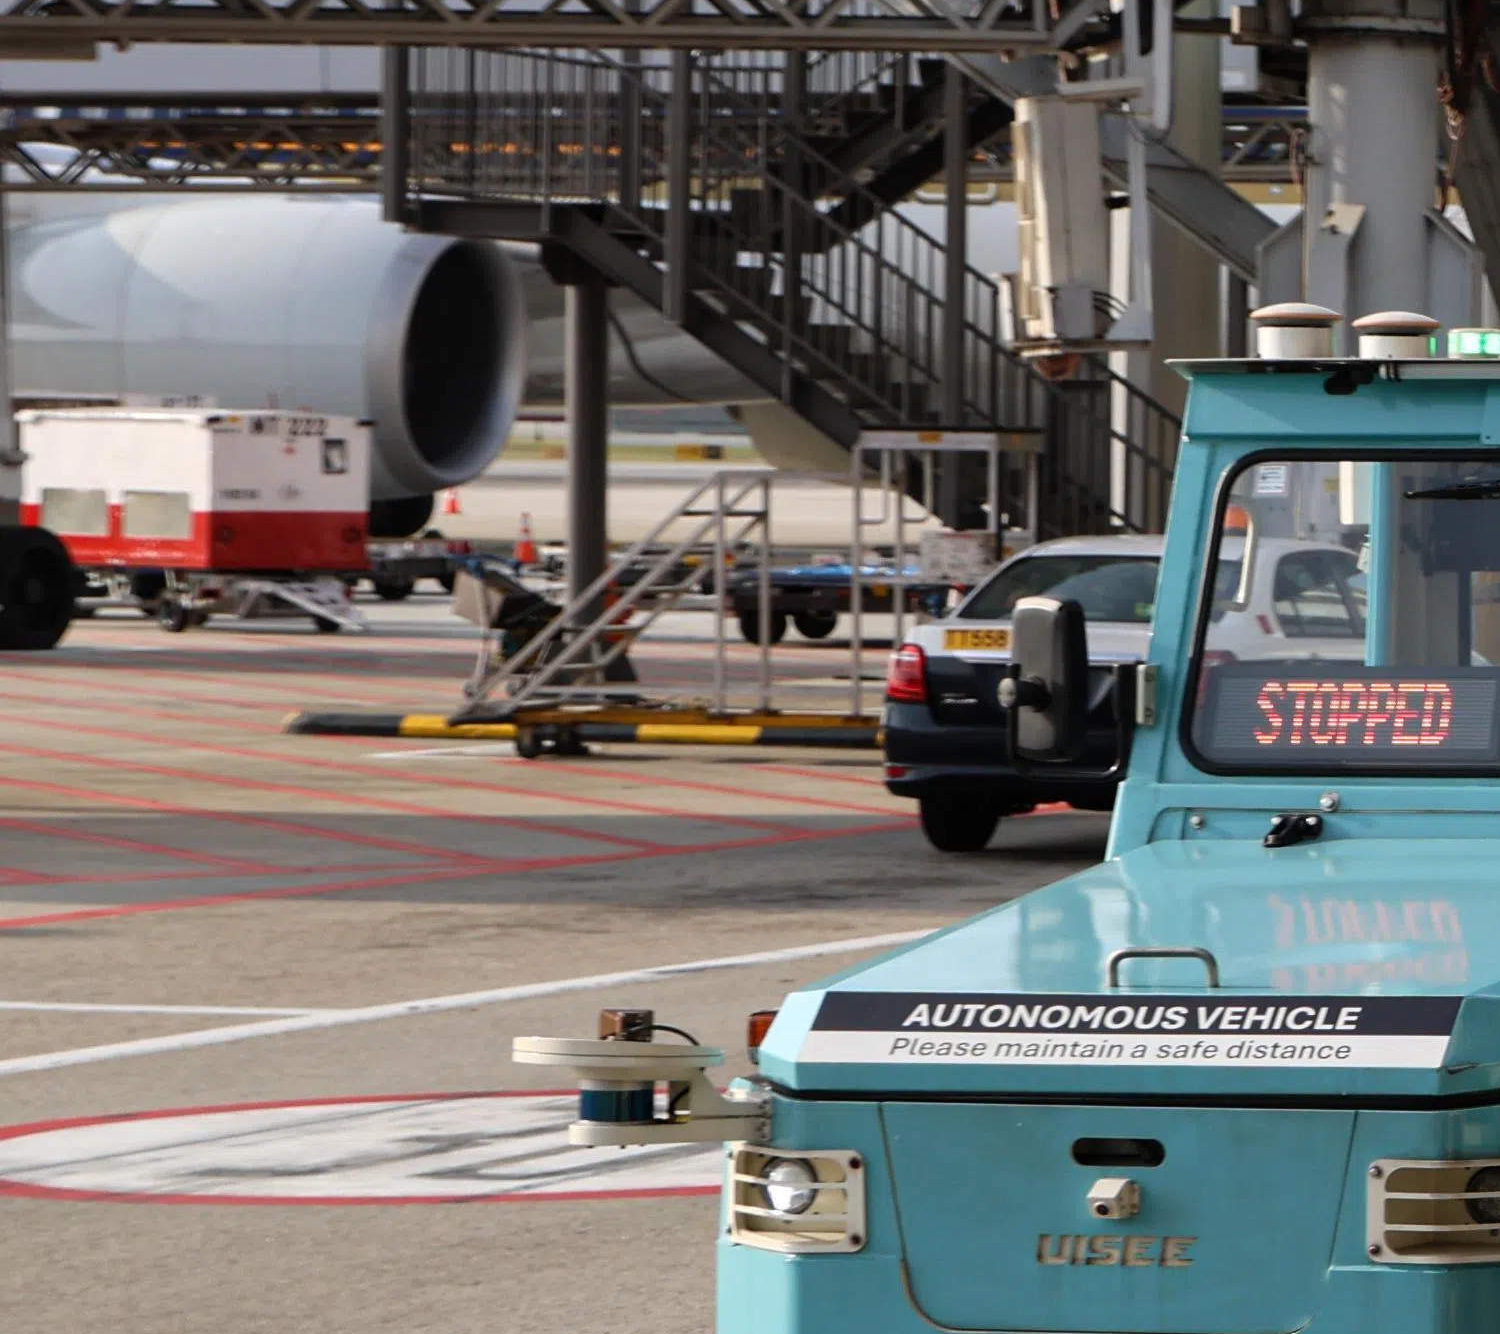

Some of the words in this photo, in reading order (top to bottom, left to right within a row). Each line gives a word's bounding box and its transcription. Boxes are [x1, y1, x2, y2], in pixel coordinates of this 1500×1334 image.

[1254, 681, 1452, 746] STOPPED
[903, 1003, 1188, 1030] AUTONOMOUS
[1196, 1006, 1362, 1031] VEHICLE
[889, 1037, 987, 1058] Please
[993, 1038, 1124, 1060] maintain
[1129, 1046, 1146, 1059] a
[1156, 1040, 1220, 1060] safe
[1225, 1041, 1353, 1061] distance
[1037, 1233, 1199, 1268] UISEE
